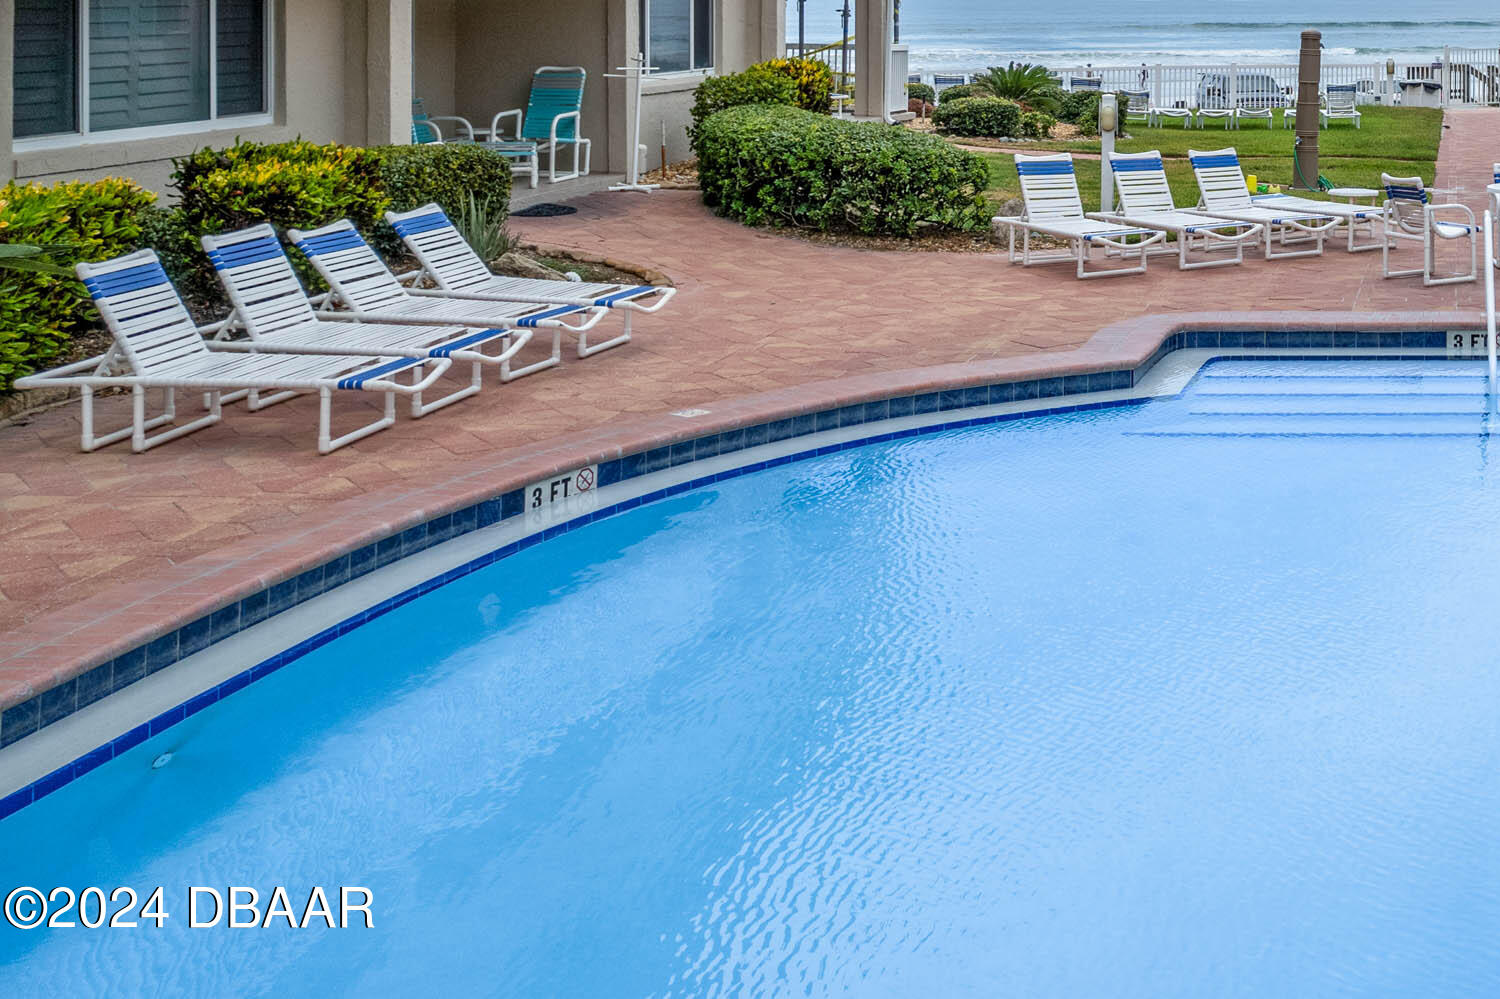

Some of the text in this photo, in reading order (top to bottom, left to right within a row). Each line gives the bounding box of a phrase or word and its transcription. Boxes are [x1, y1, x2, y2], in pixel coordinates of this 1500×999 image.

[1453, 333, 1464, 348] 3
[532, 477, 571, 509] 3 FT
